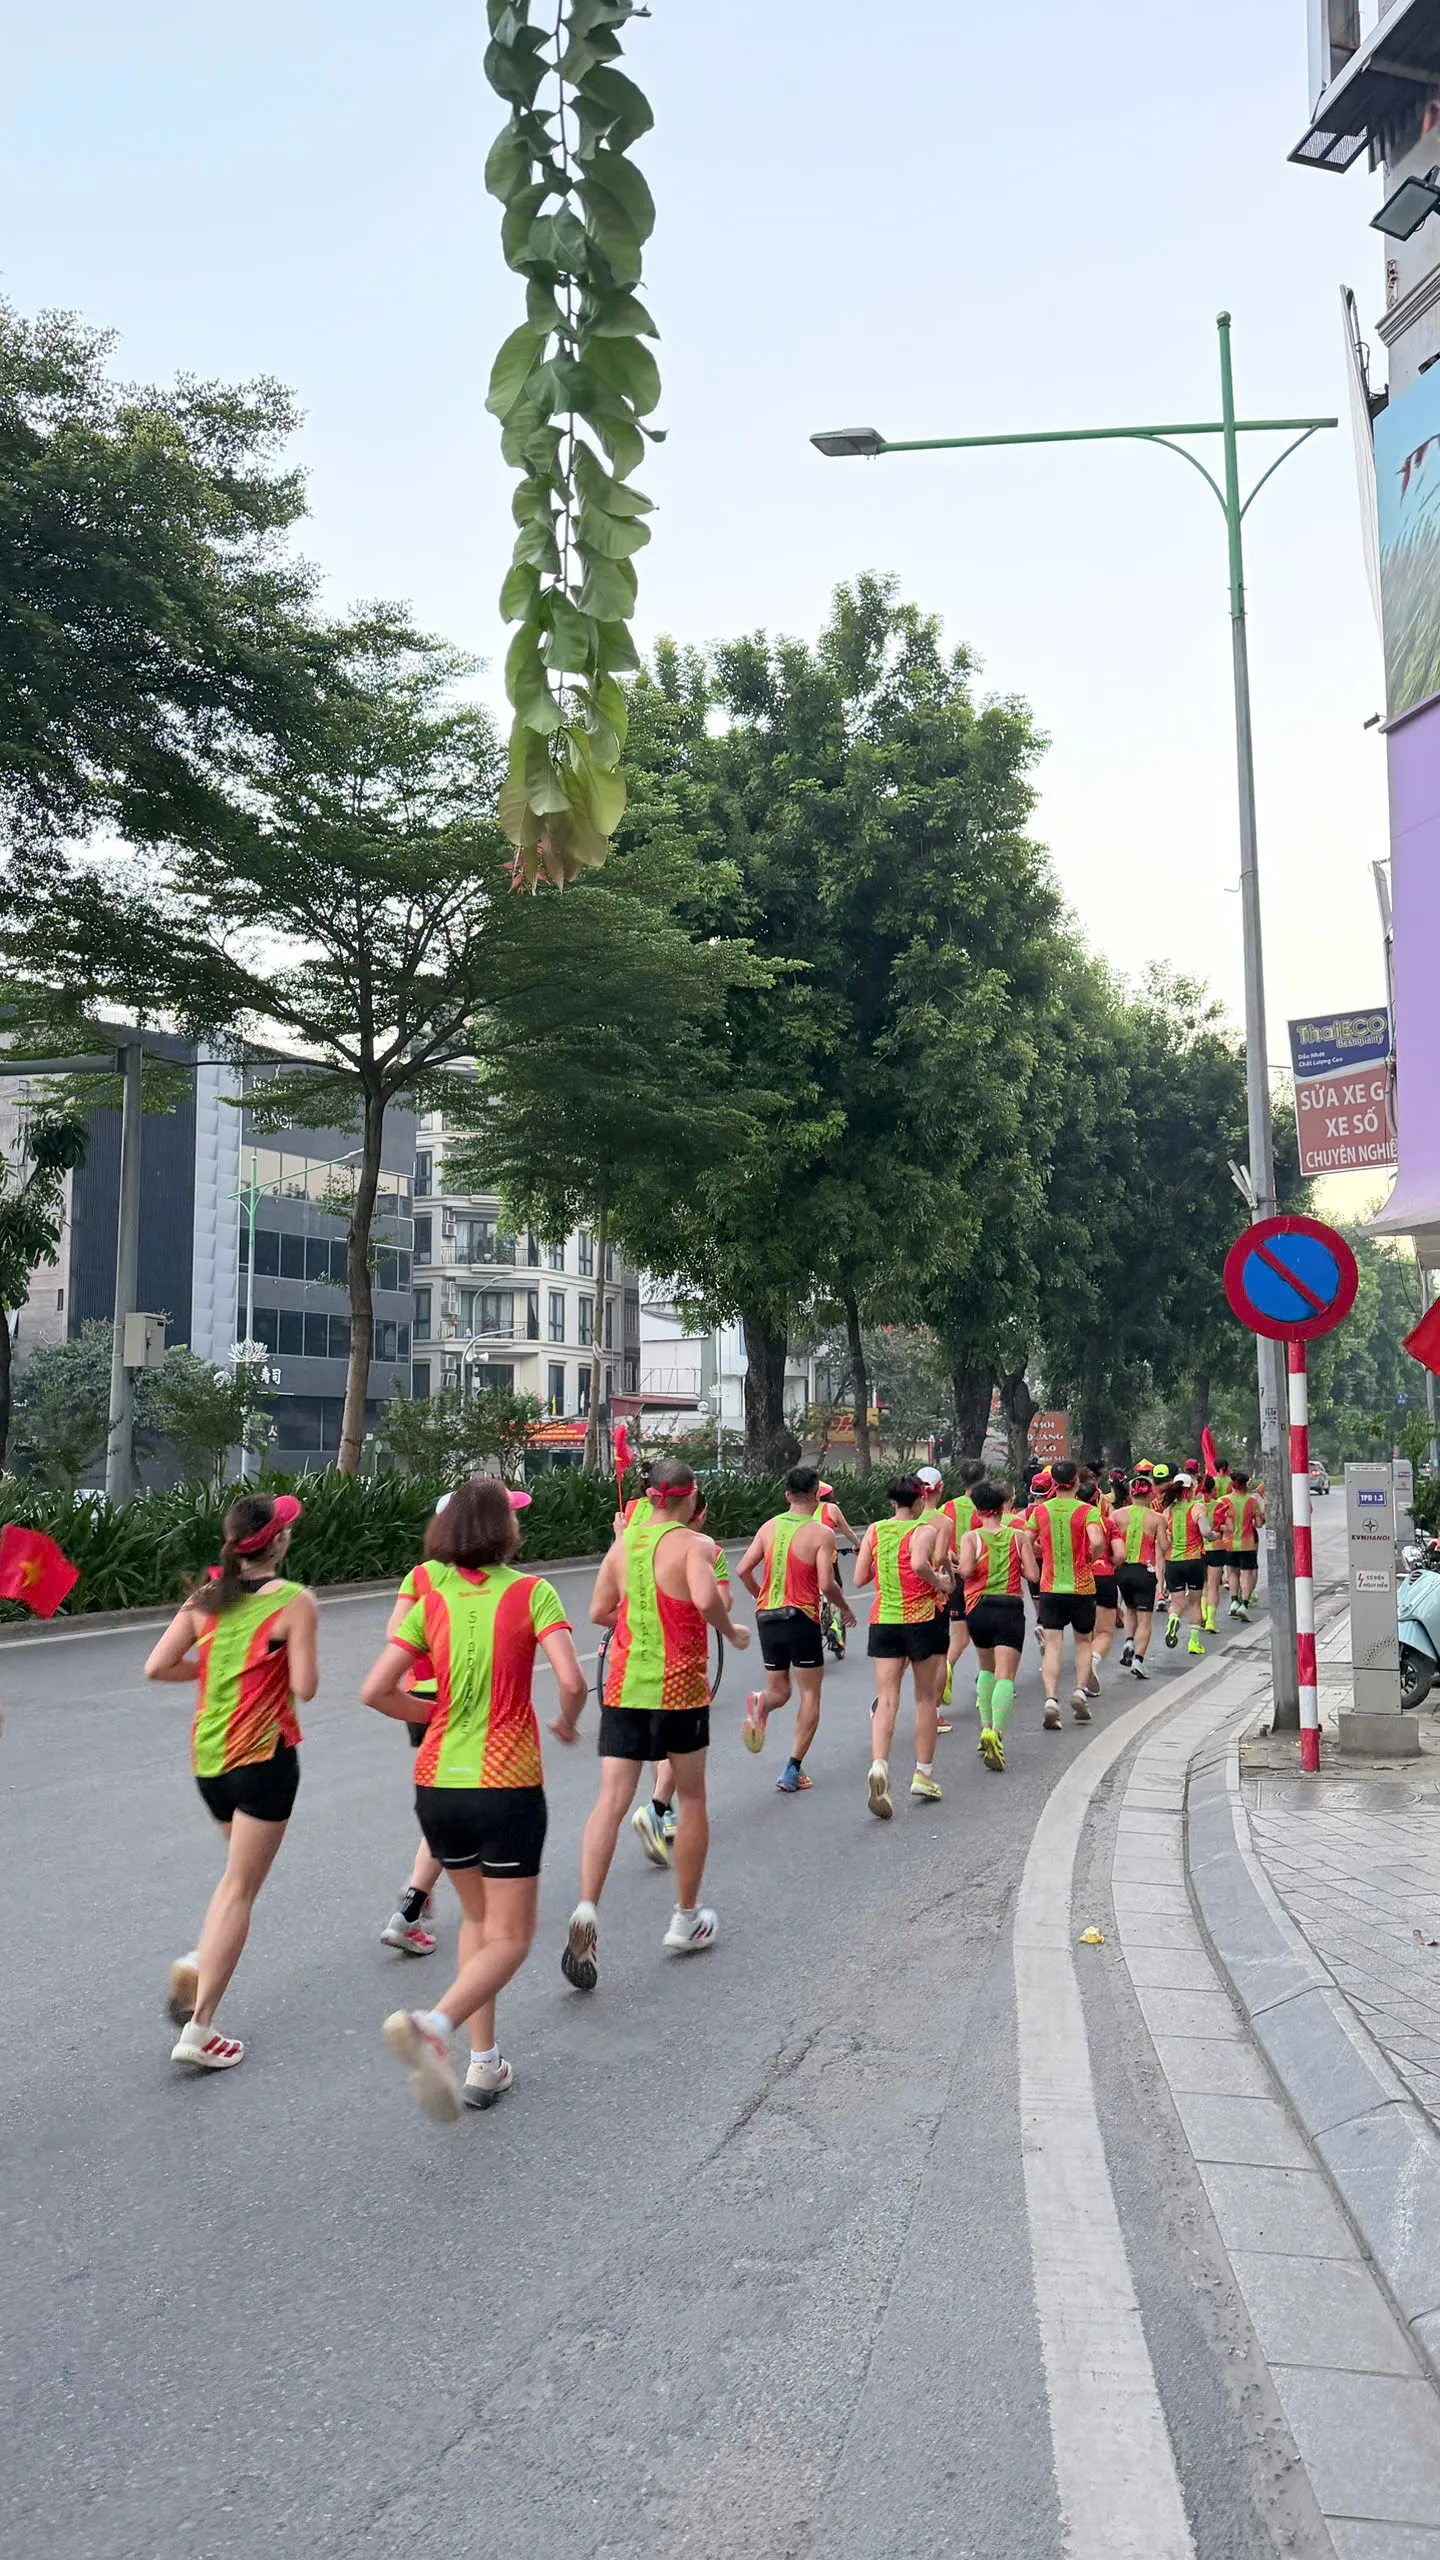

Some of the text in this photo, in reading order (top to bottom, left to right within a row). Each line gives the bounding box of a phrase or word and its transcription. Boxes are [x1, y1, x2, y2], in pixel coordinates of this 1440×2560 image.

[1296, 1015, 1387, 1044] ThaiECO
[1300, 1081, 1385, 1111] SỬA XE G
[1325, 1106, 1379, 1138] XE SỐ
[1306, 1138, 1398, 1168] CHUYÊN NGHIỆ
